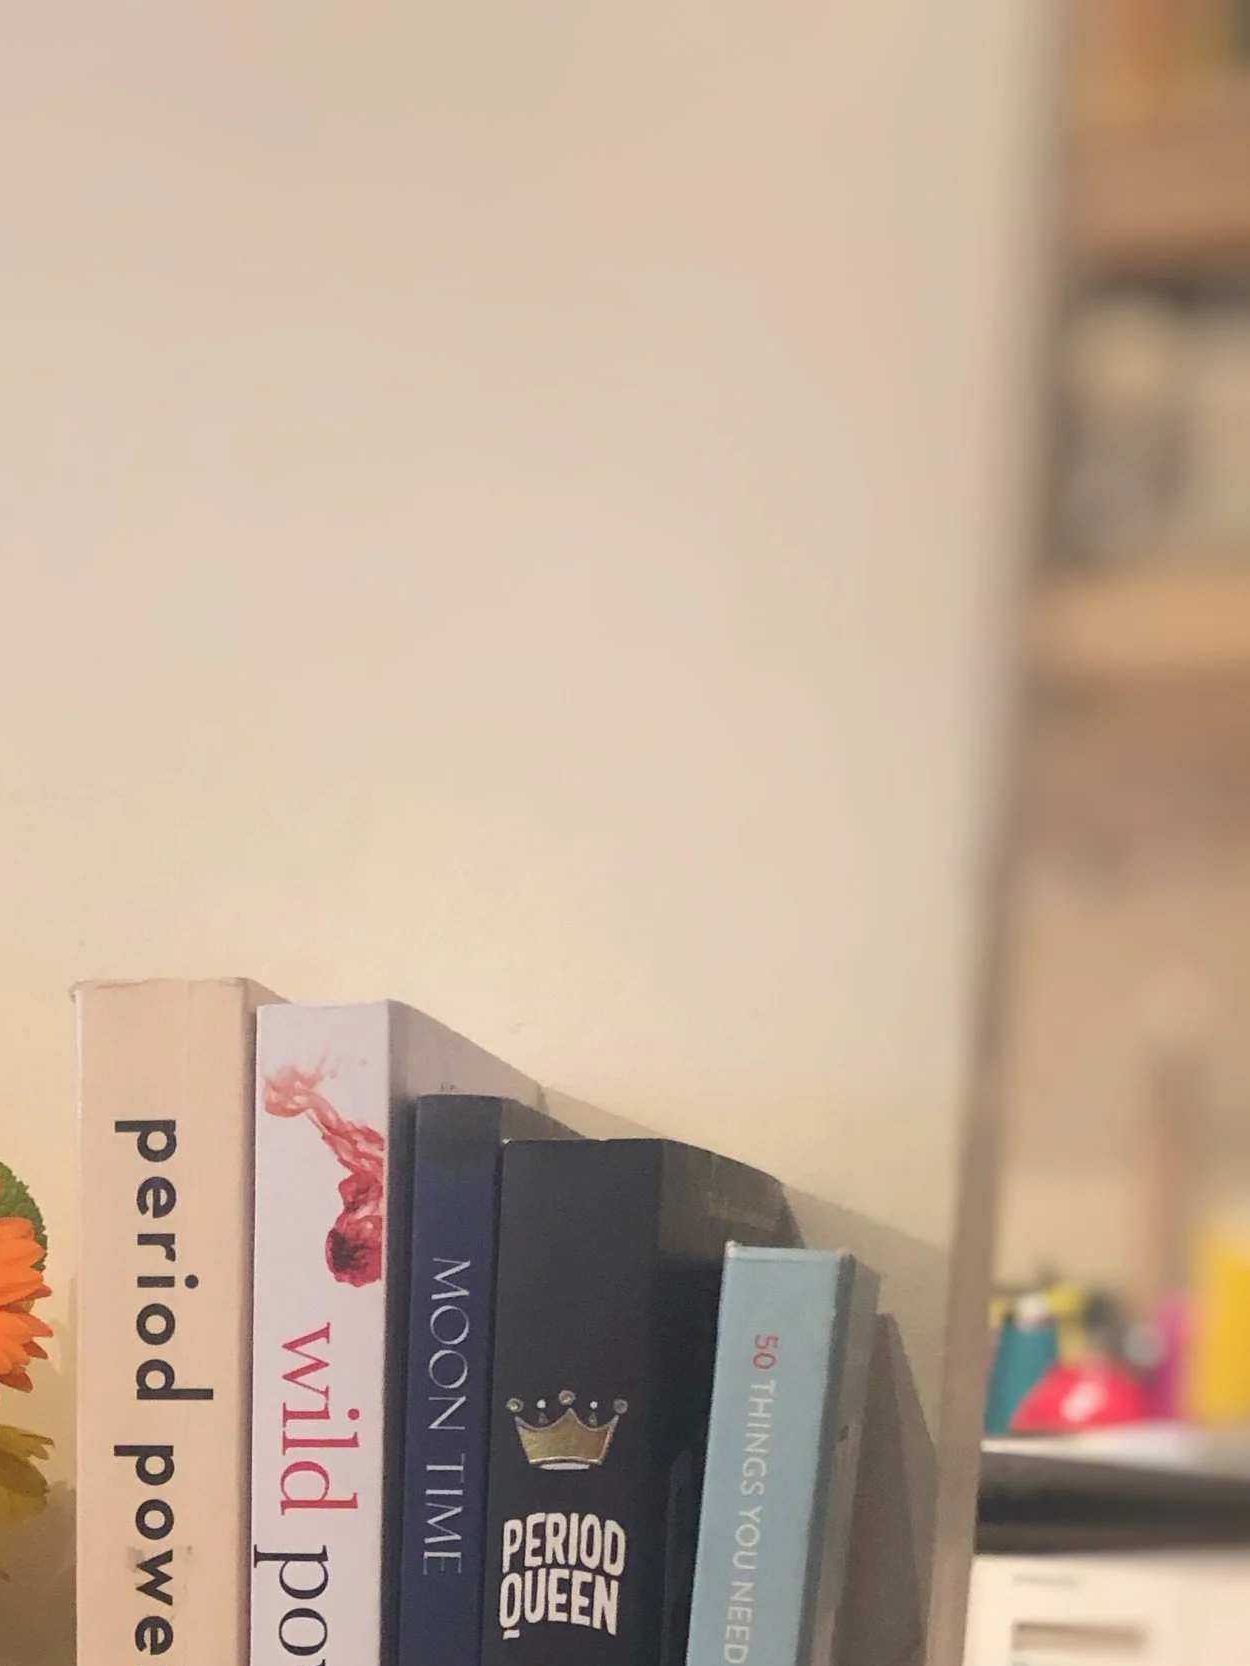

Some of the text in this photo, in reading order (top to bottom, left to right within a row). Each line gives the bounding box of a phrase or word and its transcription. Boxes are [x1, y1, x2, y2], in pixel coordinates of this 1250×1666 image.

[115, 1120, 214, 1401] period
[753, 1334, 779, 1369] 50
[281, 1322, 359, 1516] wild
[423, 1257, 472, 1576] MOON TIME
[741, 1379, 777, 1497] THINGS
[502, 1512, 625, 1575] PERIOD
[733, 1505, 764, 1571] YOU
[499, 1569, 618, 1639] QUEEN
[724, 1578, 755, 1665] NEED
